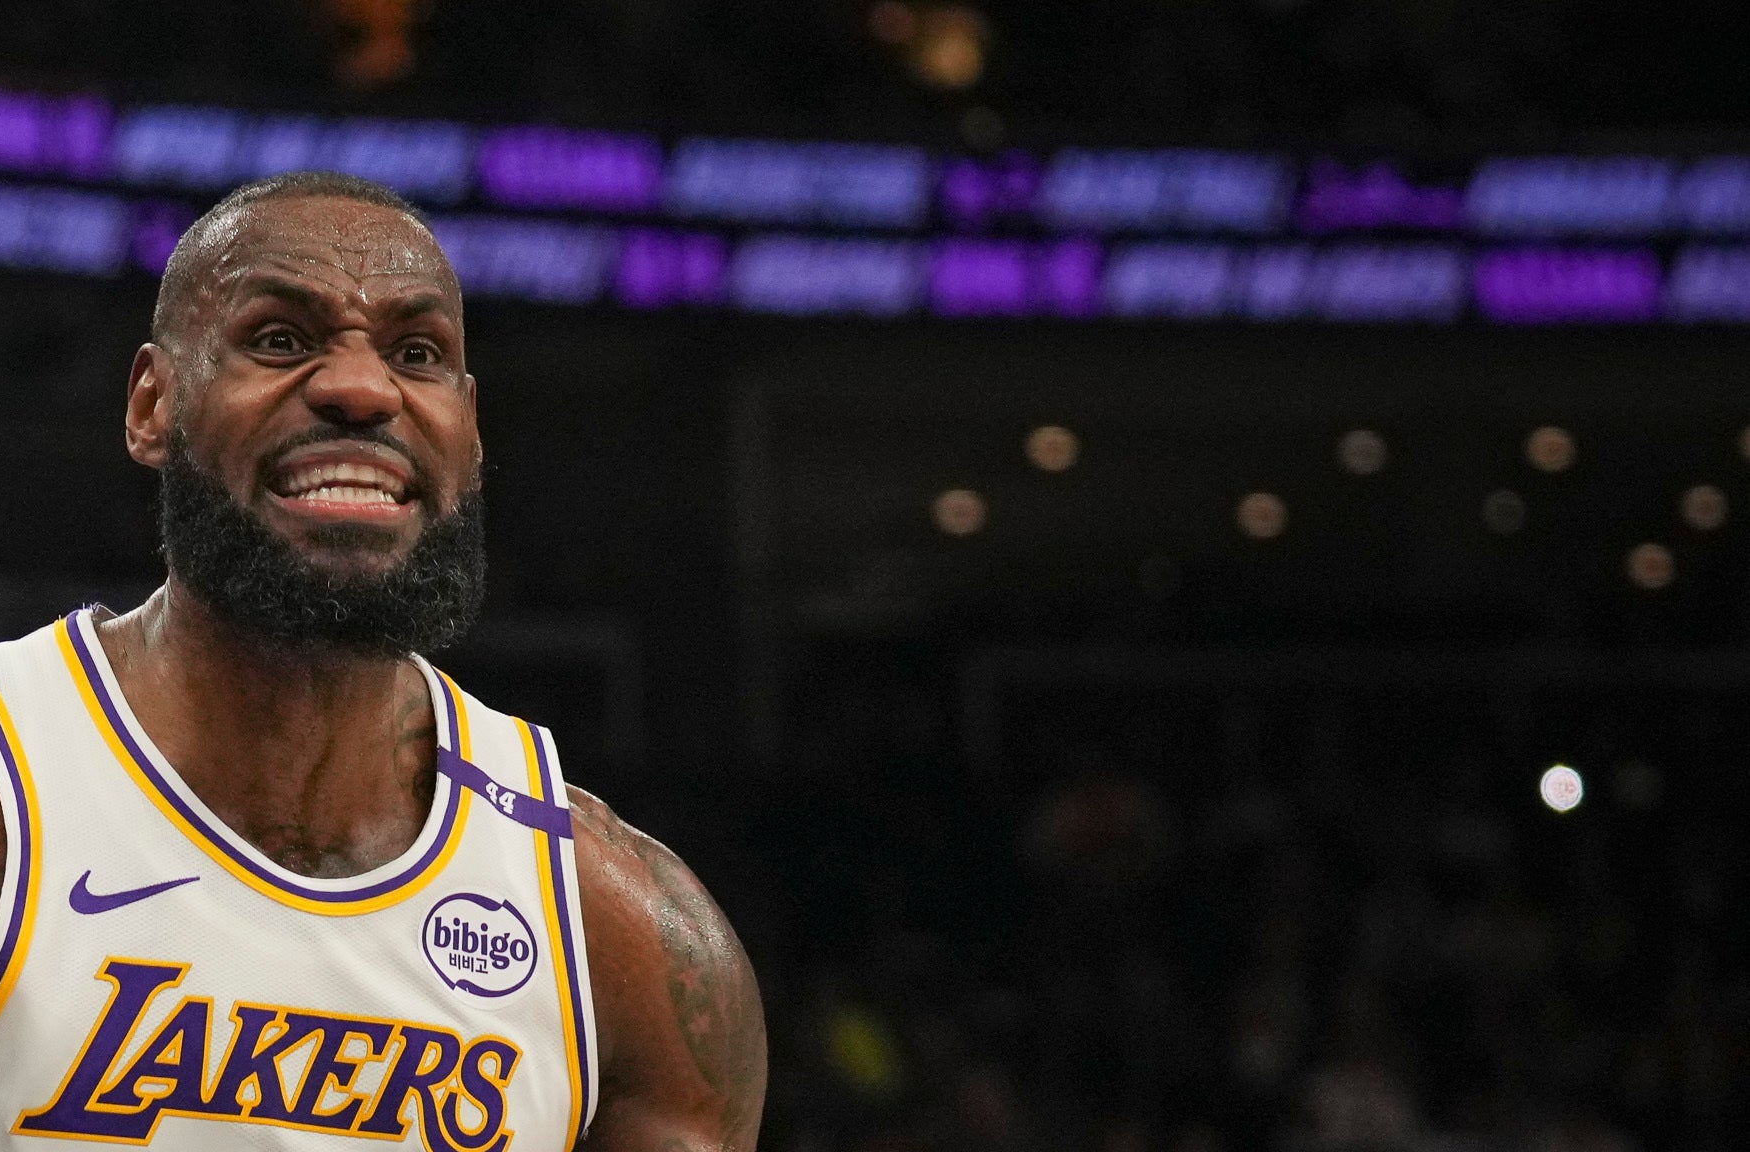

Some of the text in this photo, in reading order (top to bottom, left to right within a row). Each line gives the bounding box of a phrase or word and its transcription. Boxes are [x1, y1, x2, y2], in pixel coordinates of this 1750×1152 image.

[485, 781, 517, 815] 44
[433, 916, 530, 970] bibigo
[449, 952, 489, 975] 비비고
